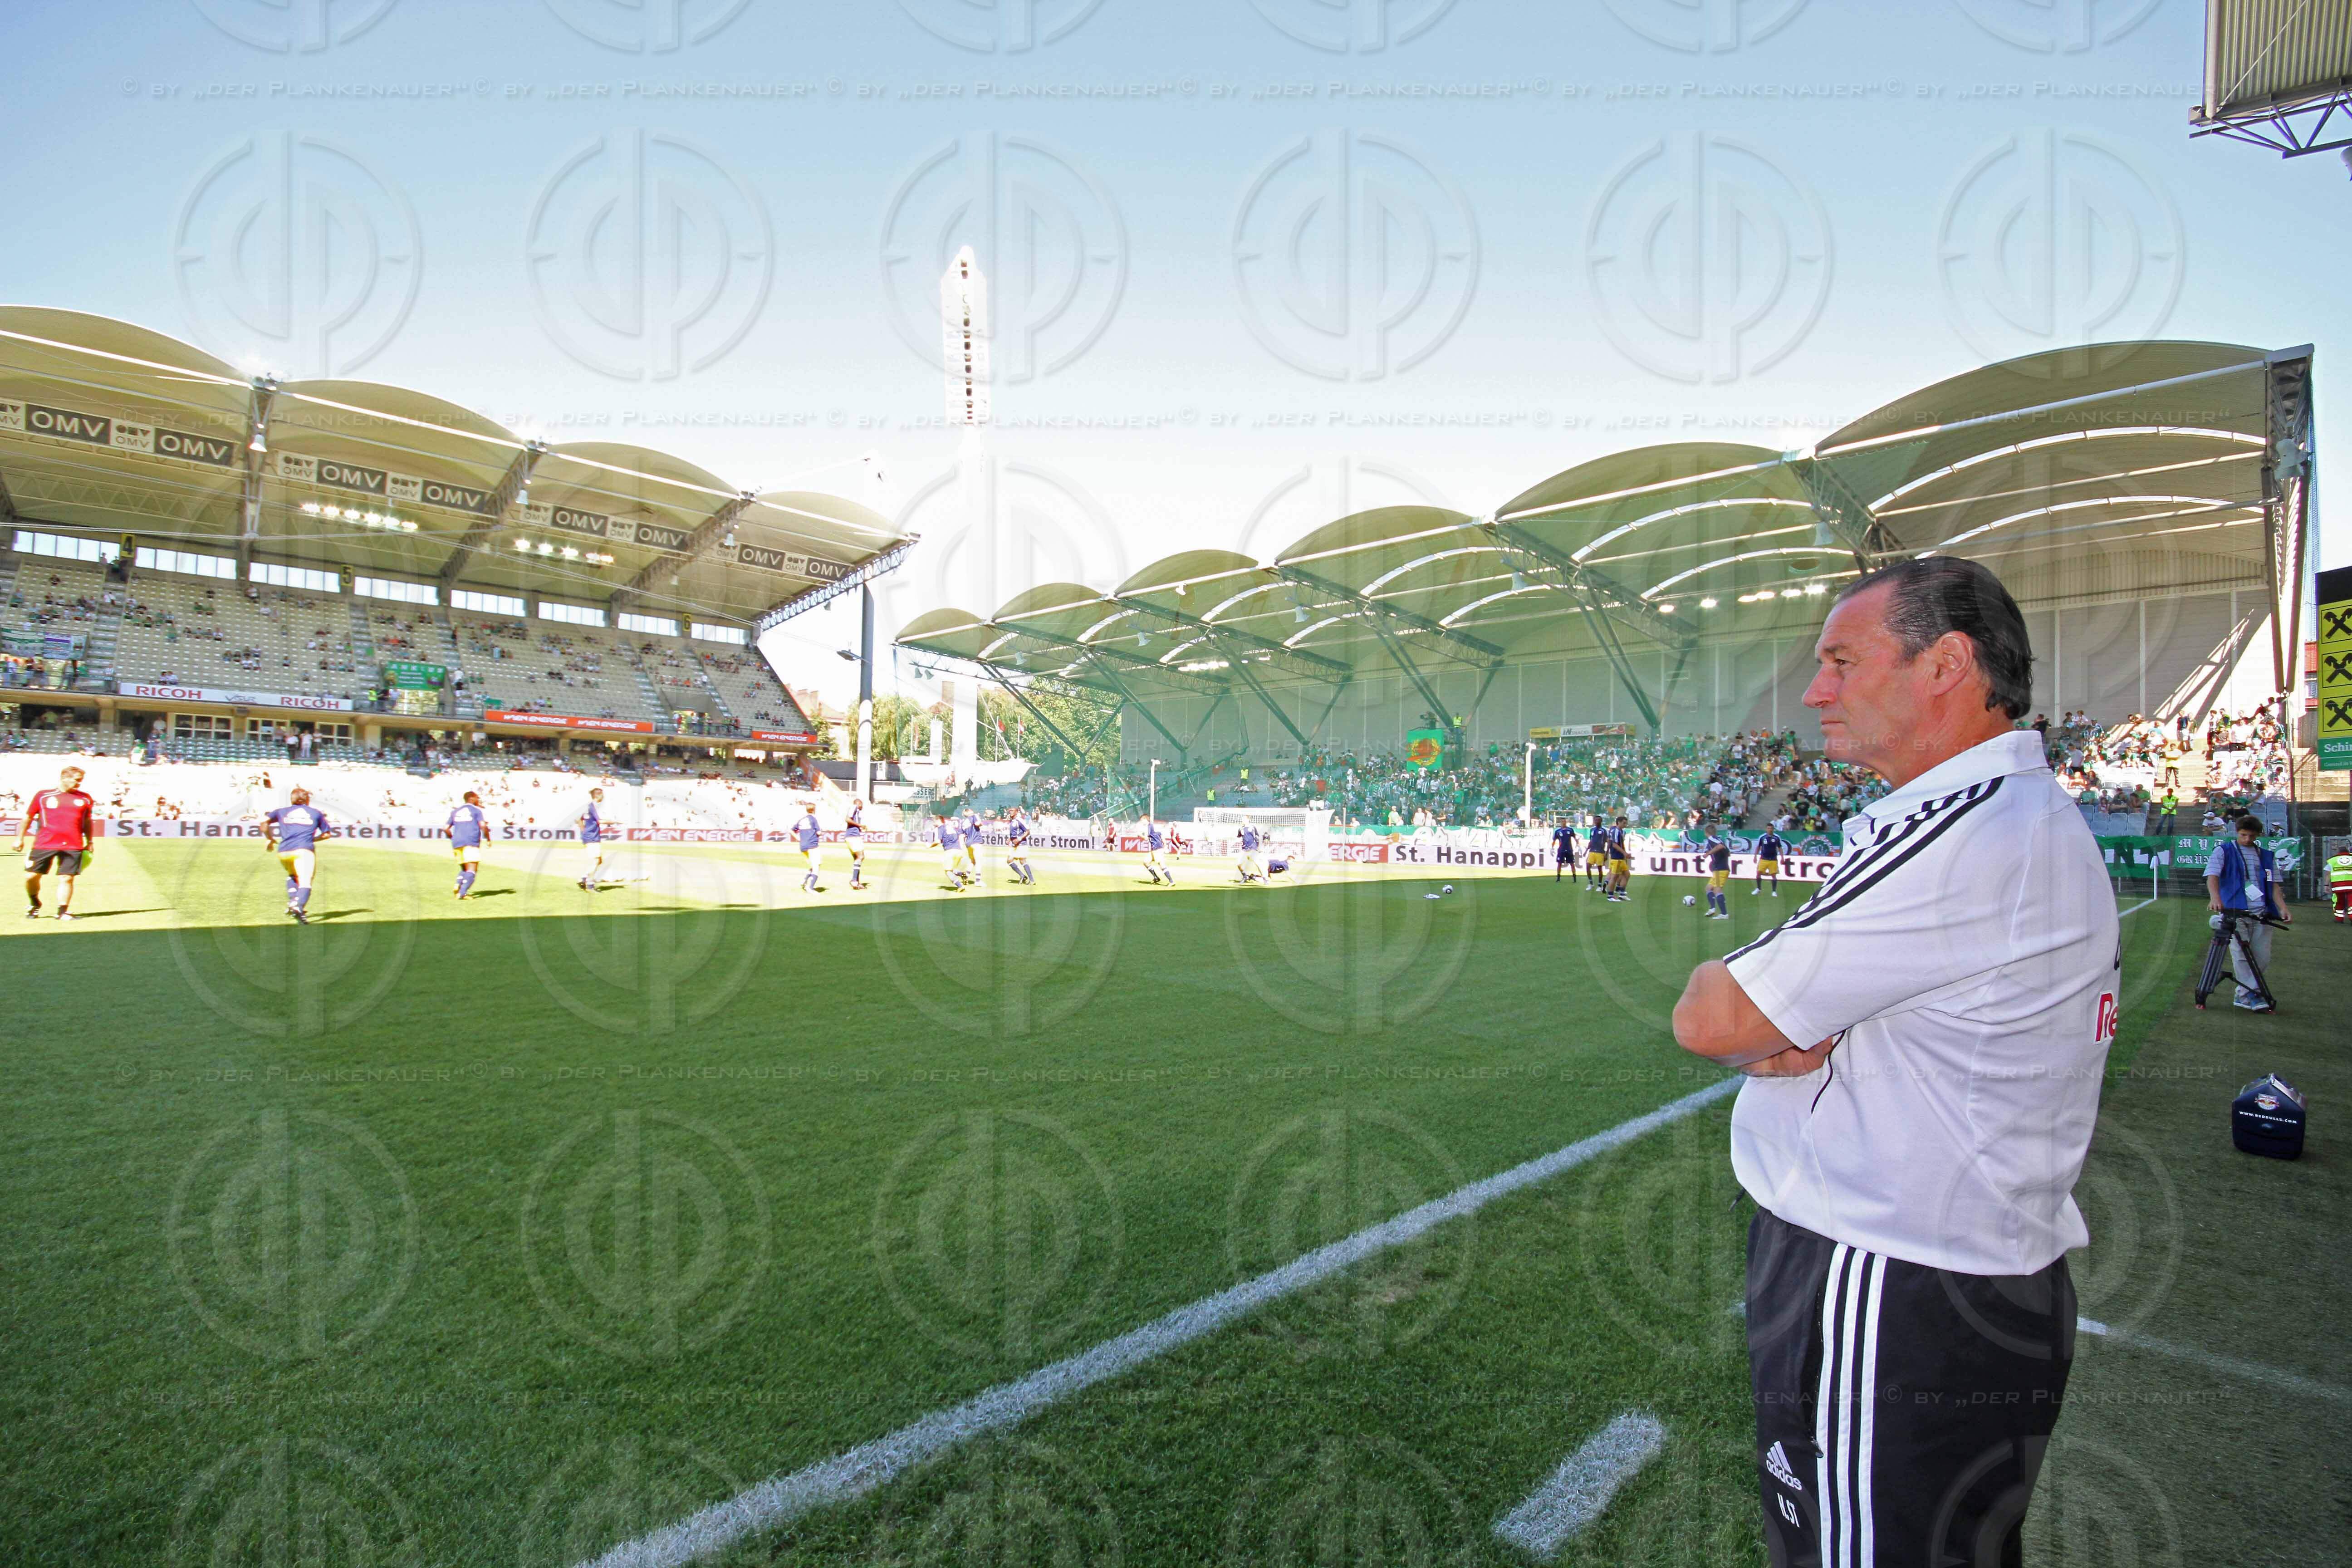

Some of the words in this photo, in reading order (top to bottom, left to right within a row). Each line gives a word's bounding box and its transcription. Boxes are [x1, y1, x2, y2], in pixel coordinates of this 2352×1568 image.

[32, 411, 105, 437] OMV
[116, 436, 150, 448] OMV
[160, 435, 228, 460] OMV
[283, 466, 312, 477] OMV
[322, 465, 382, 488] OMV
[426, 485, 481, 507] OMV
[556, 511, 604, 530] OMV
[123, 536, 133, 554] 4
[638, 527, 683, 546] OMV
[742, 549, 782, 565] OMV
[343, 567, 352, 584] 5
[809, 562, 845, 578] OMV
[136, 686, 201, 699] RICOH
[281, 696, 339, 709] RICOH
[118, 820, 162, 836] St.
[180, 821, 280, 837] Hanap
[330, 824, 406, 838] steht
[503, 827, 575, 839] Strom
[633, 829, 680, 841] WIEN
[683, 830, 757, 842] ENERGIE
[1029, 836, 1045, 847] ter
[1051, 835, 1095, 849] Strom!
[1125, 840, 1149, 851] WIE
[1329, 845, 1383, 861] ERGIE
[1396, 845, 1425, 862] St.
[1437, 847, 1544, 868] Hanappi
[1650, 855, 1743, 875] untr
[1766, 1460, 1802, 1490] adidas
